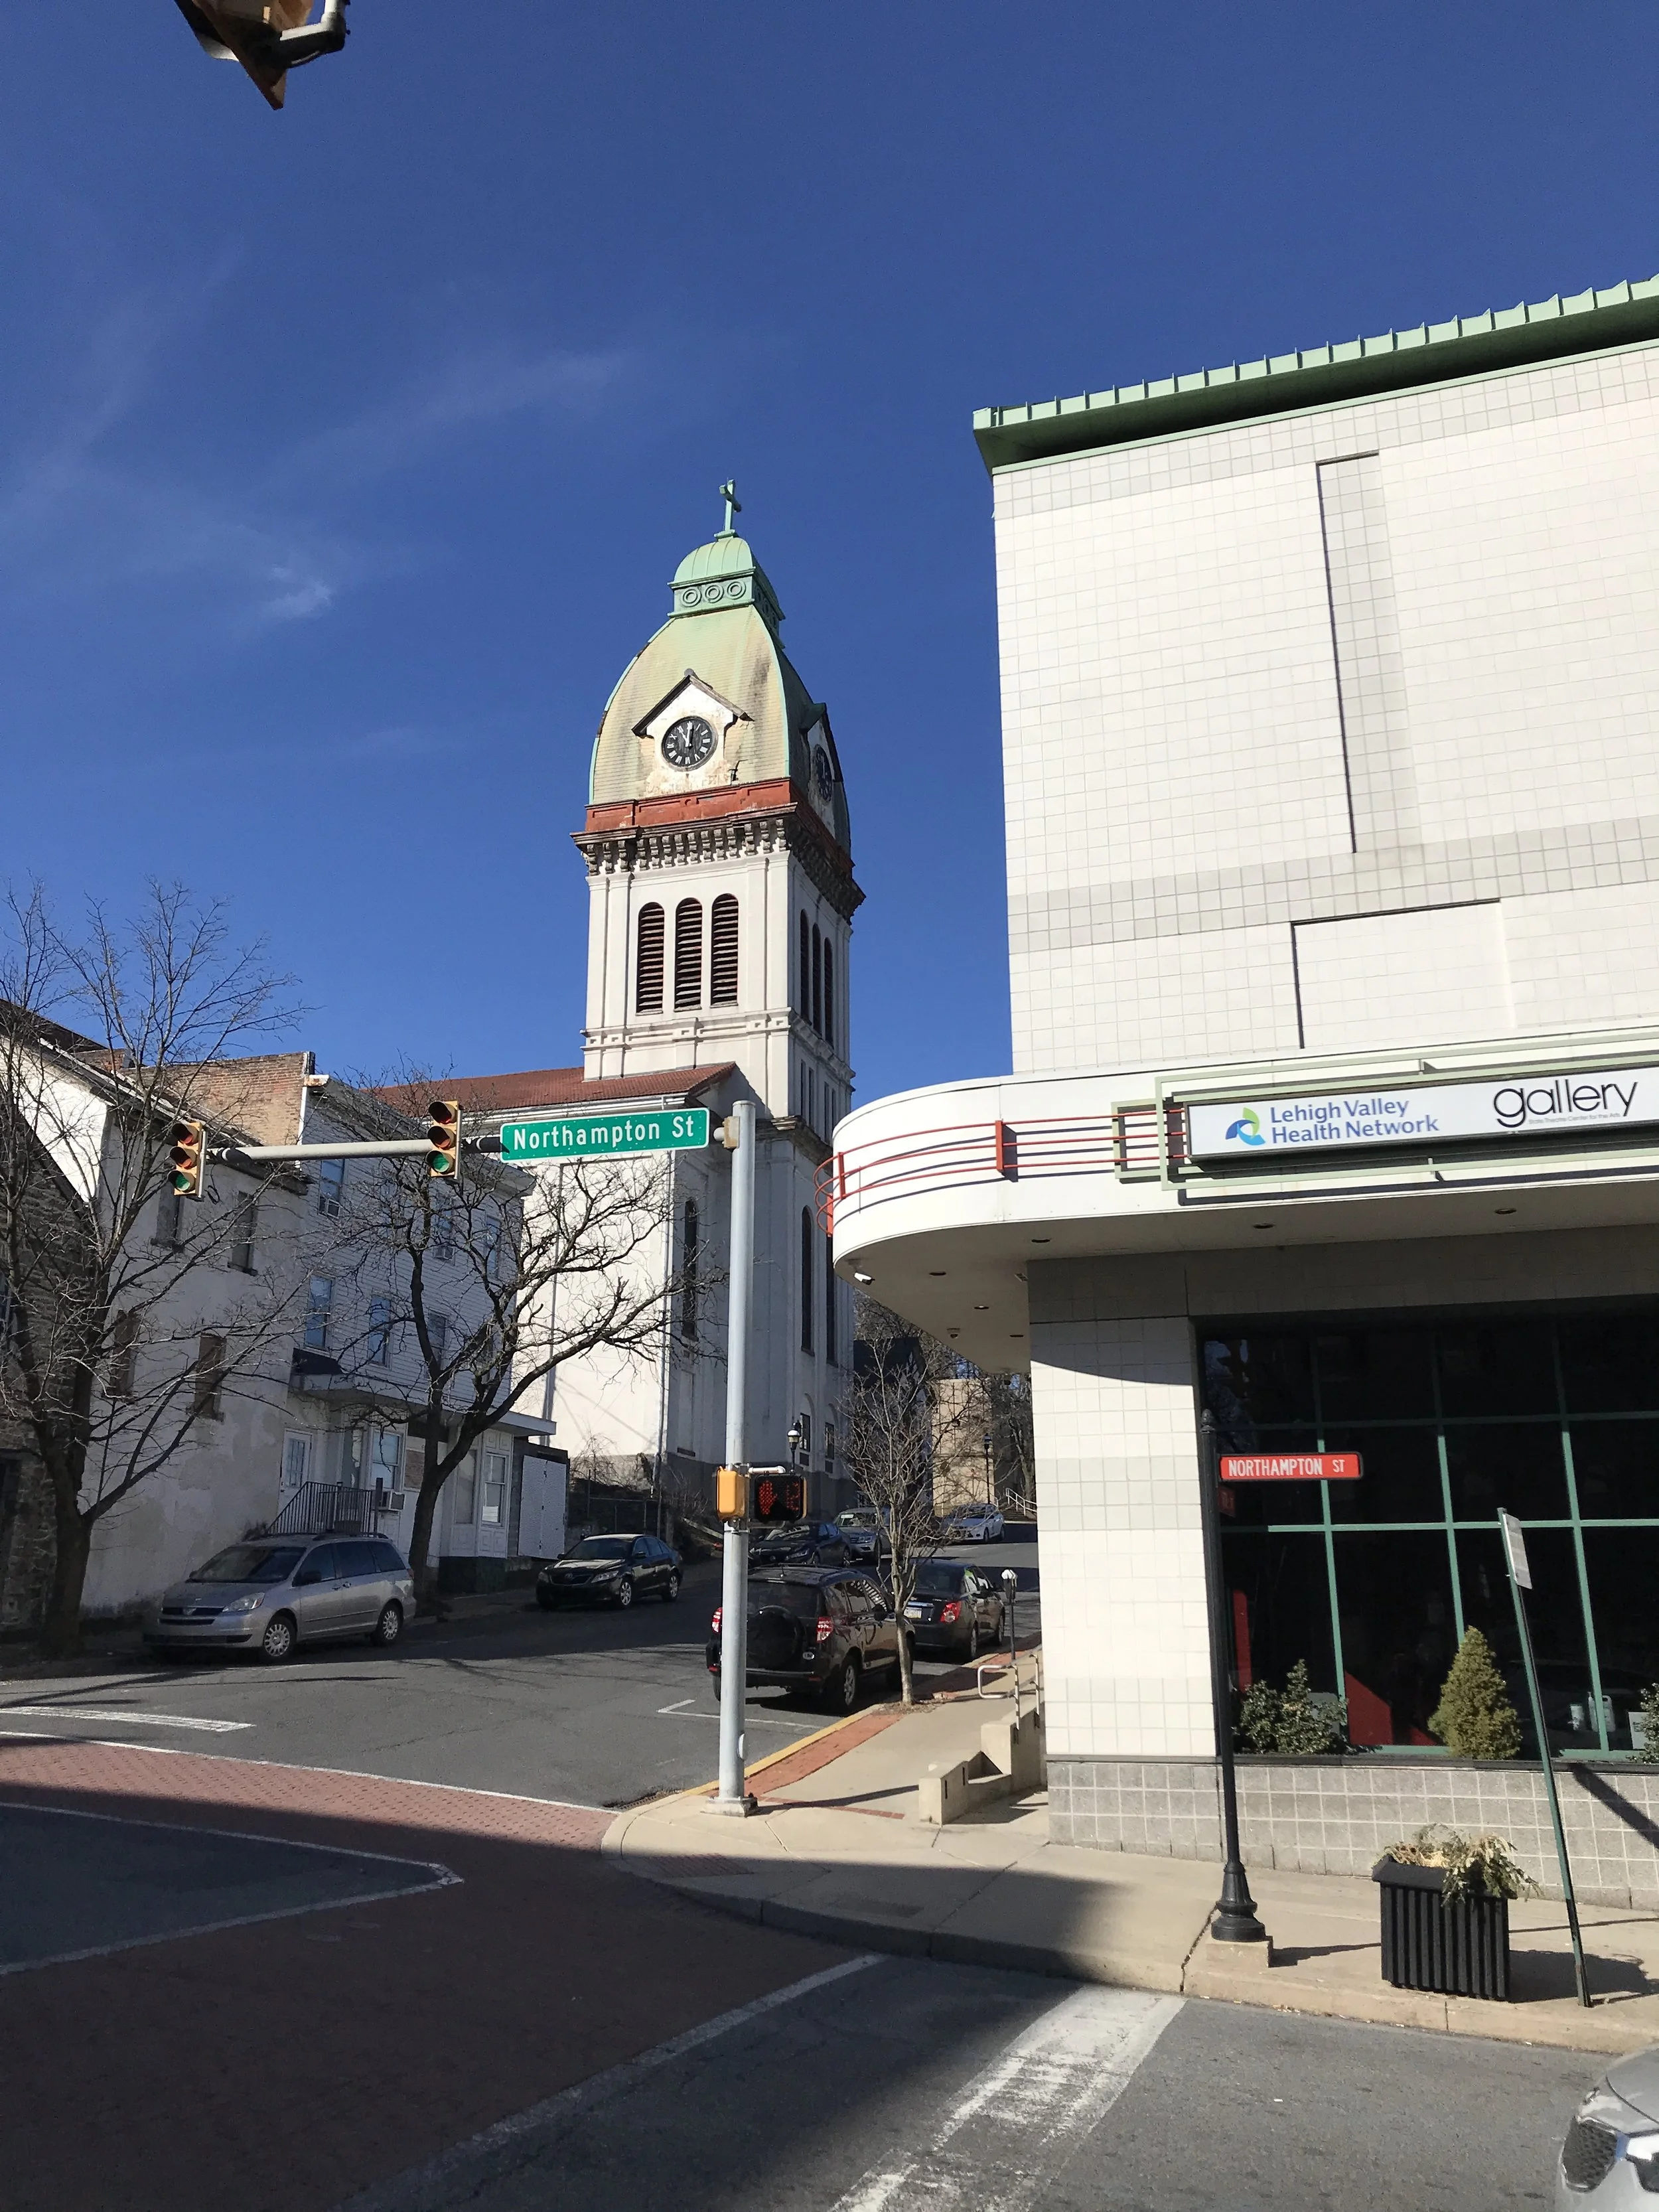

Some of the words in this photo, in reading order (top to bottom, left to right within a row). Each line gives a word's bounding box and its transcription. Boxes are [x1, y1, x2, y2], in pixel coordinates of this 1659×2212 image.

[1270, 1102, 1341, 1124] Lehigh
[1343, 1098, 1409, 1118] Valley
[1493, 1079, 1638, 1128] gallery
[514, 1120, 660, 1149] Northampton
[672, 1116, 694, 1138] St
[1272, 1122, 1340, 1143] Health
[1345, 1114, 1439, 1138] Network
[1228, 1458, 1323, 1477] NORTHAMPTON
[1332, 1459, 1345, 1473] ST
